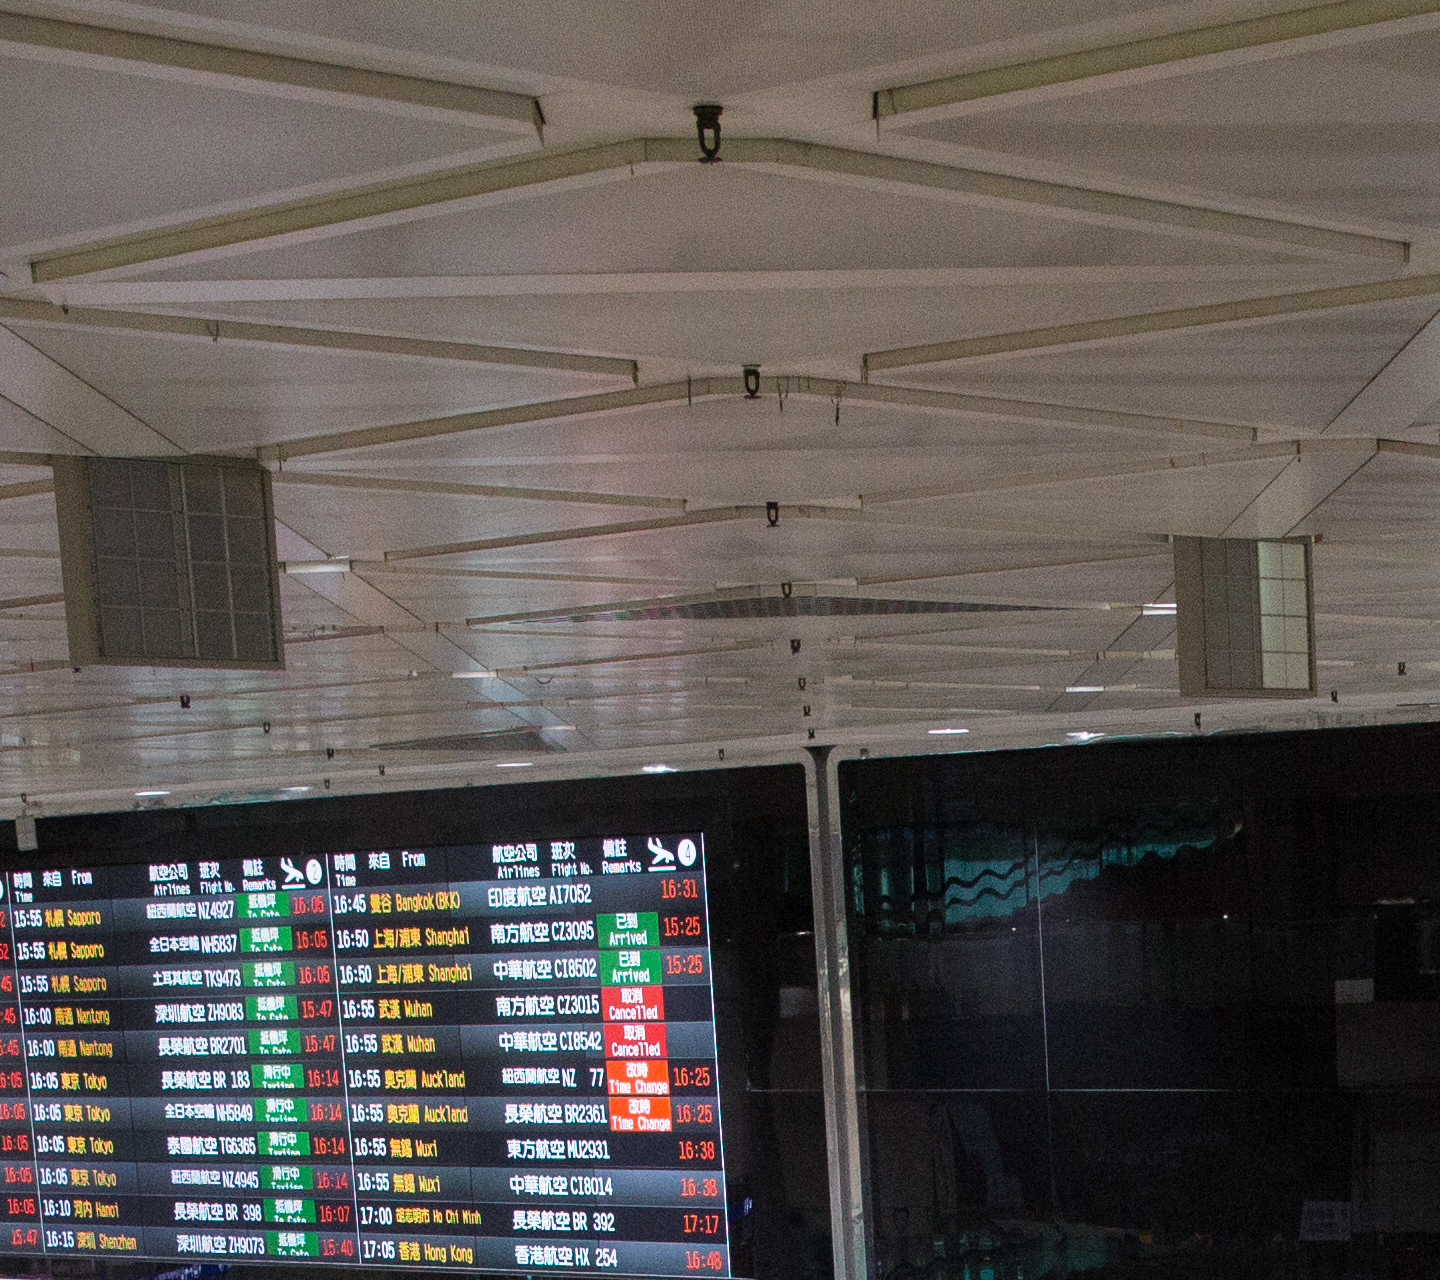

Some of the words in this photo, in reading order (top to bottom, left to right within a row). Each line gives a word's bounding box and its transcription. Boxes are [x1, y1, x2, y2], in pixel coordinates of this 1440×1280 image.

[333, 893, 367, 914] 16:45
[370, 893, 391, 913] 曼谷
[395, 891, 459, 913] Bangkok(BKK)
[487, 885, 548, 908] 印度航空
[549, 883, 592, 905] AI7052
[661, 878, 698, 899] 16:31
[615, 912, 639, 930] 已到
[336, 929, 369, 949] 16:50
[424, 927, 469, 946] Shanghai
[489, 921, 551, 945] 南方航空
[551, 920, 595, 941] CZ3095
[663, 915, 701, 937] 15:25
[608, 929, 648, 946] Arrived
[36, 1135, 65, 1153] 16:05
[66, 1135, 85, 1153] 東京
[91, 1137, 113, 1154] Tokyo
[167, 1135, 219, 1155] 泰國航空
[218, 1136, 257, 1155] TG6365
[313, 1137, 345, 1155] 16:14
